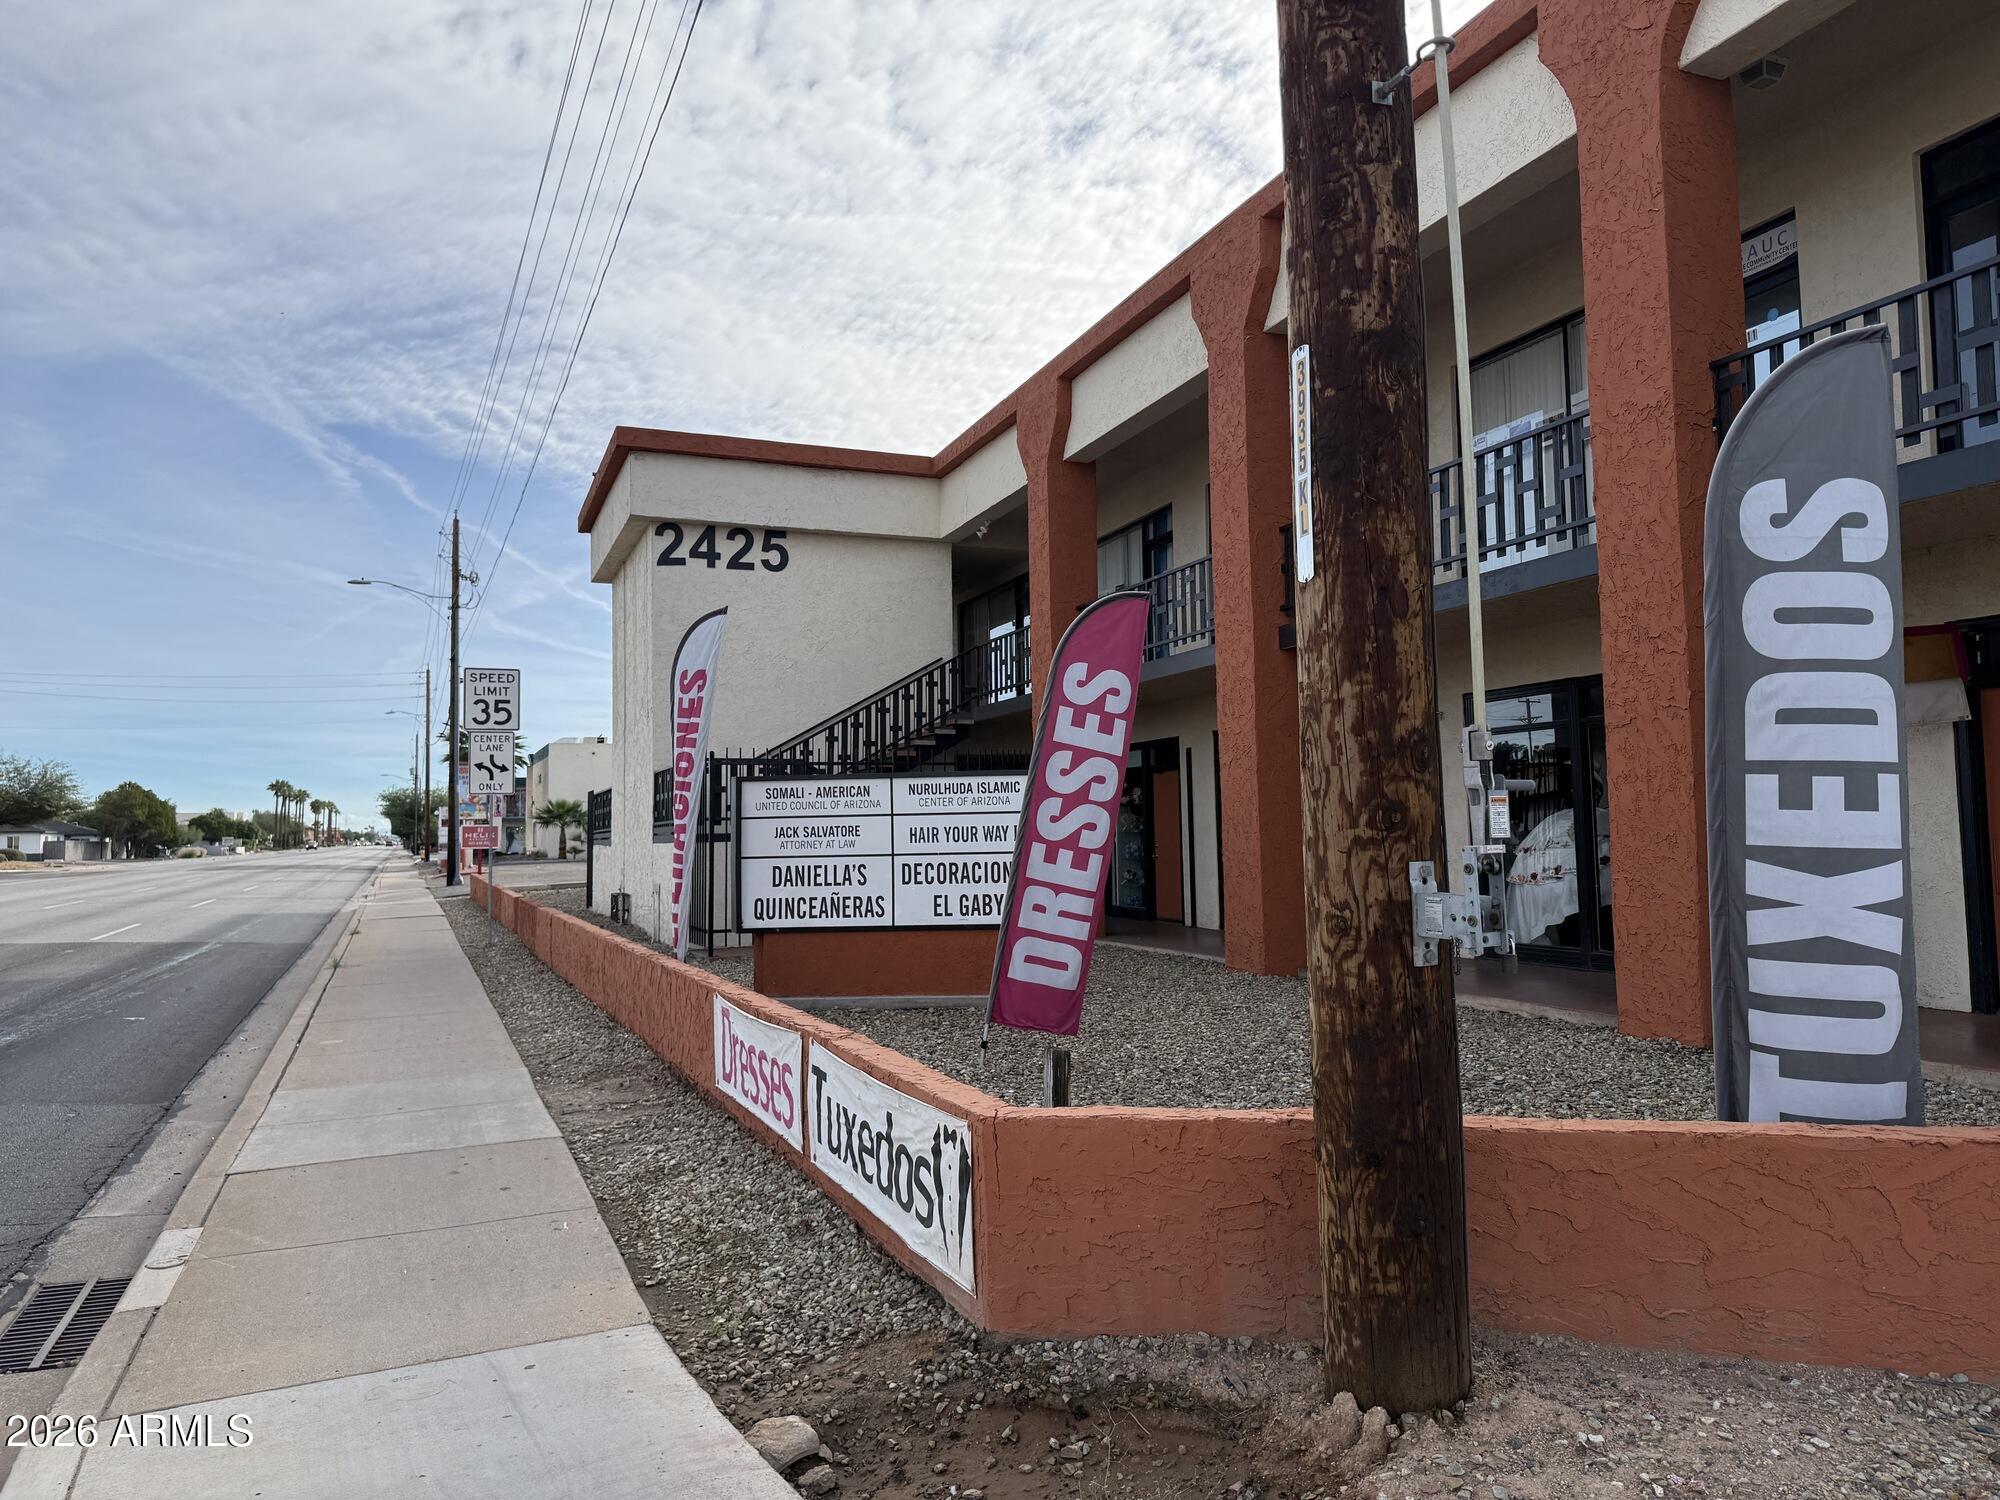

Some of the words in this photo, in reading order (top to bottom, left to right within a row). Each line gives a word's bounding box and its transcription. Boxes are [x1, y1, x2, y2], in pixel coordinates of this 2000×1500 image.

[654, 521, 789, 572] 2425
[470, 672, 515, 683] SPEED
[474, 686, 510, 696] LIMIT
[472, 698, 512, 725] 35
[473, 735, 511, 743] CENTER
[480, 744, 504, 752] LANE
[478, 783, 504, 791] ONLY
[765, 787, 804, 799] SOMALI
[815, 785, 870, 798] AMERICAN
[908, 782, 973, 796] NURULHUDA
[977, 781, 1021, 794] ISLAMIC
[755, 801, 787, 811] UNITED
[790, 800, 828, 810] COUNCIL
[830, 800, 841, 810] OF
[844, 799, 882, 809] ARIZONA
[918, 797, 953, 807] CENTER
[957, 796, 968, 806] OF
[971, 796, 1011, 806] ARIZONA
[1740, 477, 1908, 1123] TUXEDOS
[774, 826, 799, 839] JACK
[803, 825, 861, 838] SALVATORE
[1007, 661, 1133, 992] DRESSES
[909, 826, 940, 844] HAIR
[943, 825, 979, 843] YOUR
[982, 825, 1009, 842] WAY
[780, 840, 823, 850] ATTORNEY
[825, 840, 835, 849] AT
[838, 840, 856, 849] LAW
[772, 863, 867, 887] DANIELLA'S
[753, 892, 886, 921] QUINCEAÑERAS
[933, 894, 953, 918] EL
[959, 893, 1004, 917] GABY
[721, 1007, 794, 1130] Dresses
[811, 1064, 934, 1229] Tuxedos
